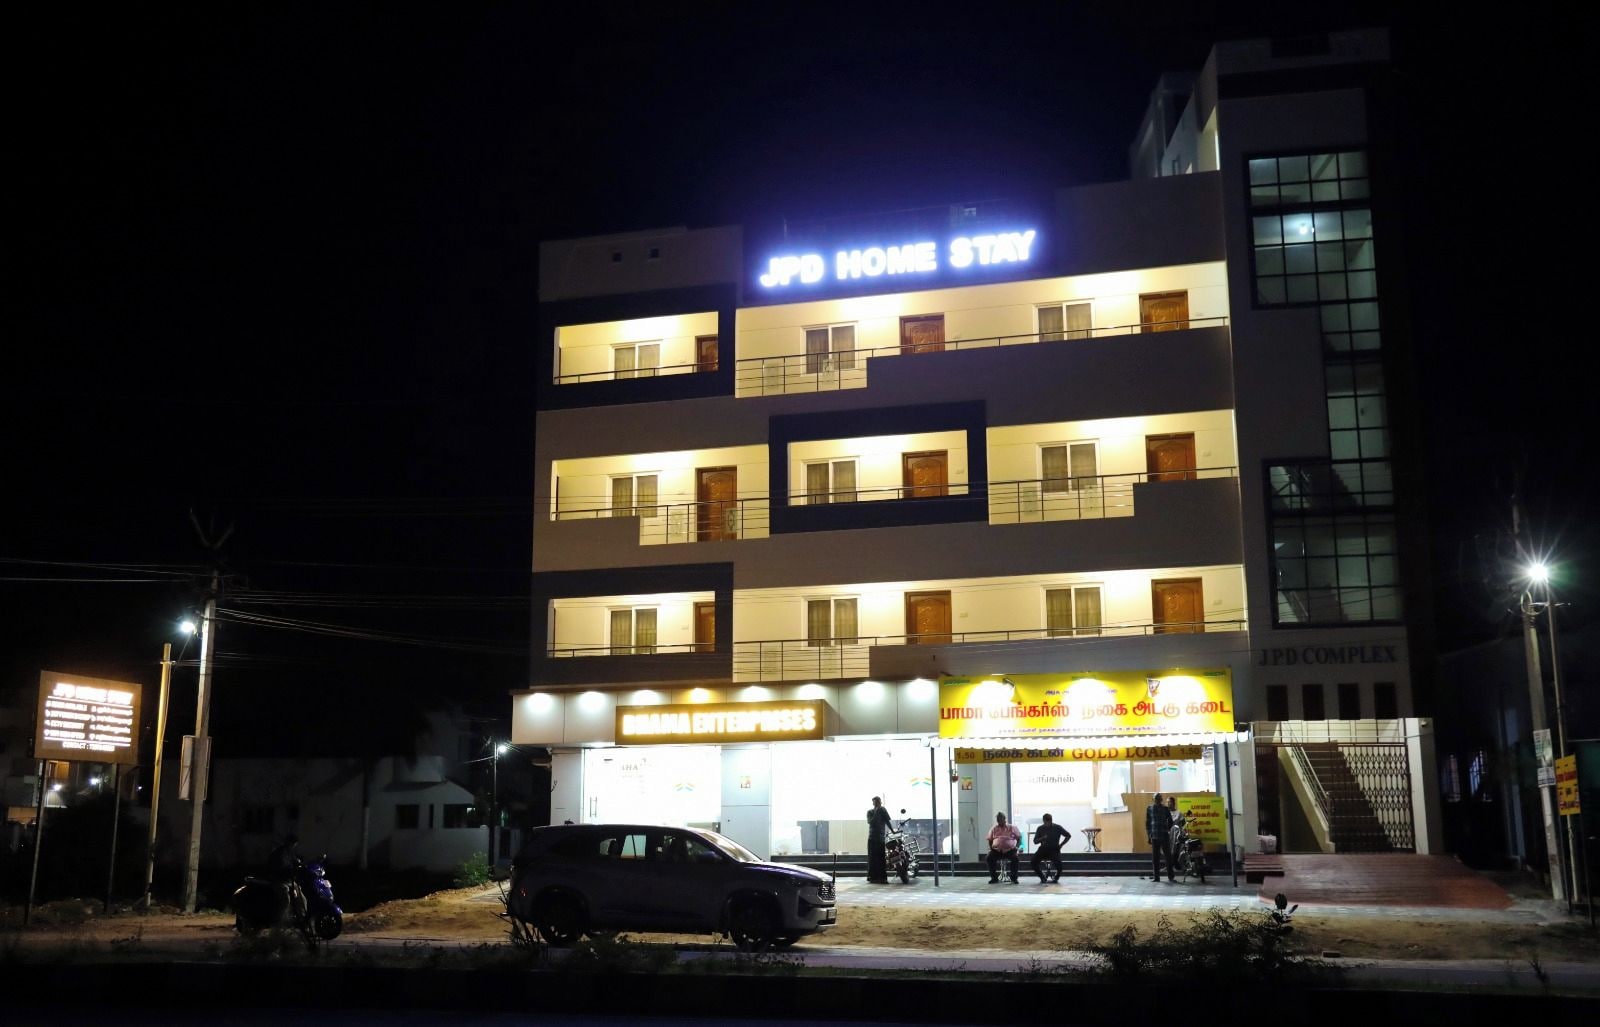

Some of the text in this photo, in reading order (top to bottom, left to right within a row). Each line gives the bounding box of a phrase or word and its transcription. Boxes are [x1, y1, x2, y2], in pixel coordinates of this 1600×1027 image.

[760, 229, 1037, 288] JPD HOME STAY
[1259, 645, 1397, 666] JPD COMPLEX
[1133, 700, 1181, 718] அடகு
[1186, 700, 1231, 715] கடை
[692, 708, 816, 733] ENTERPRISES
[1072, 747, 1119, 760] GOLD
[1125, 745, 1171, 759] LOAN
